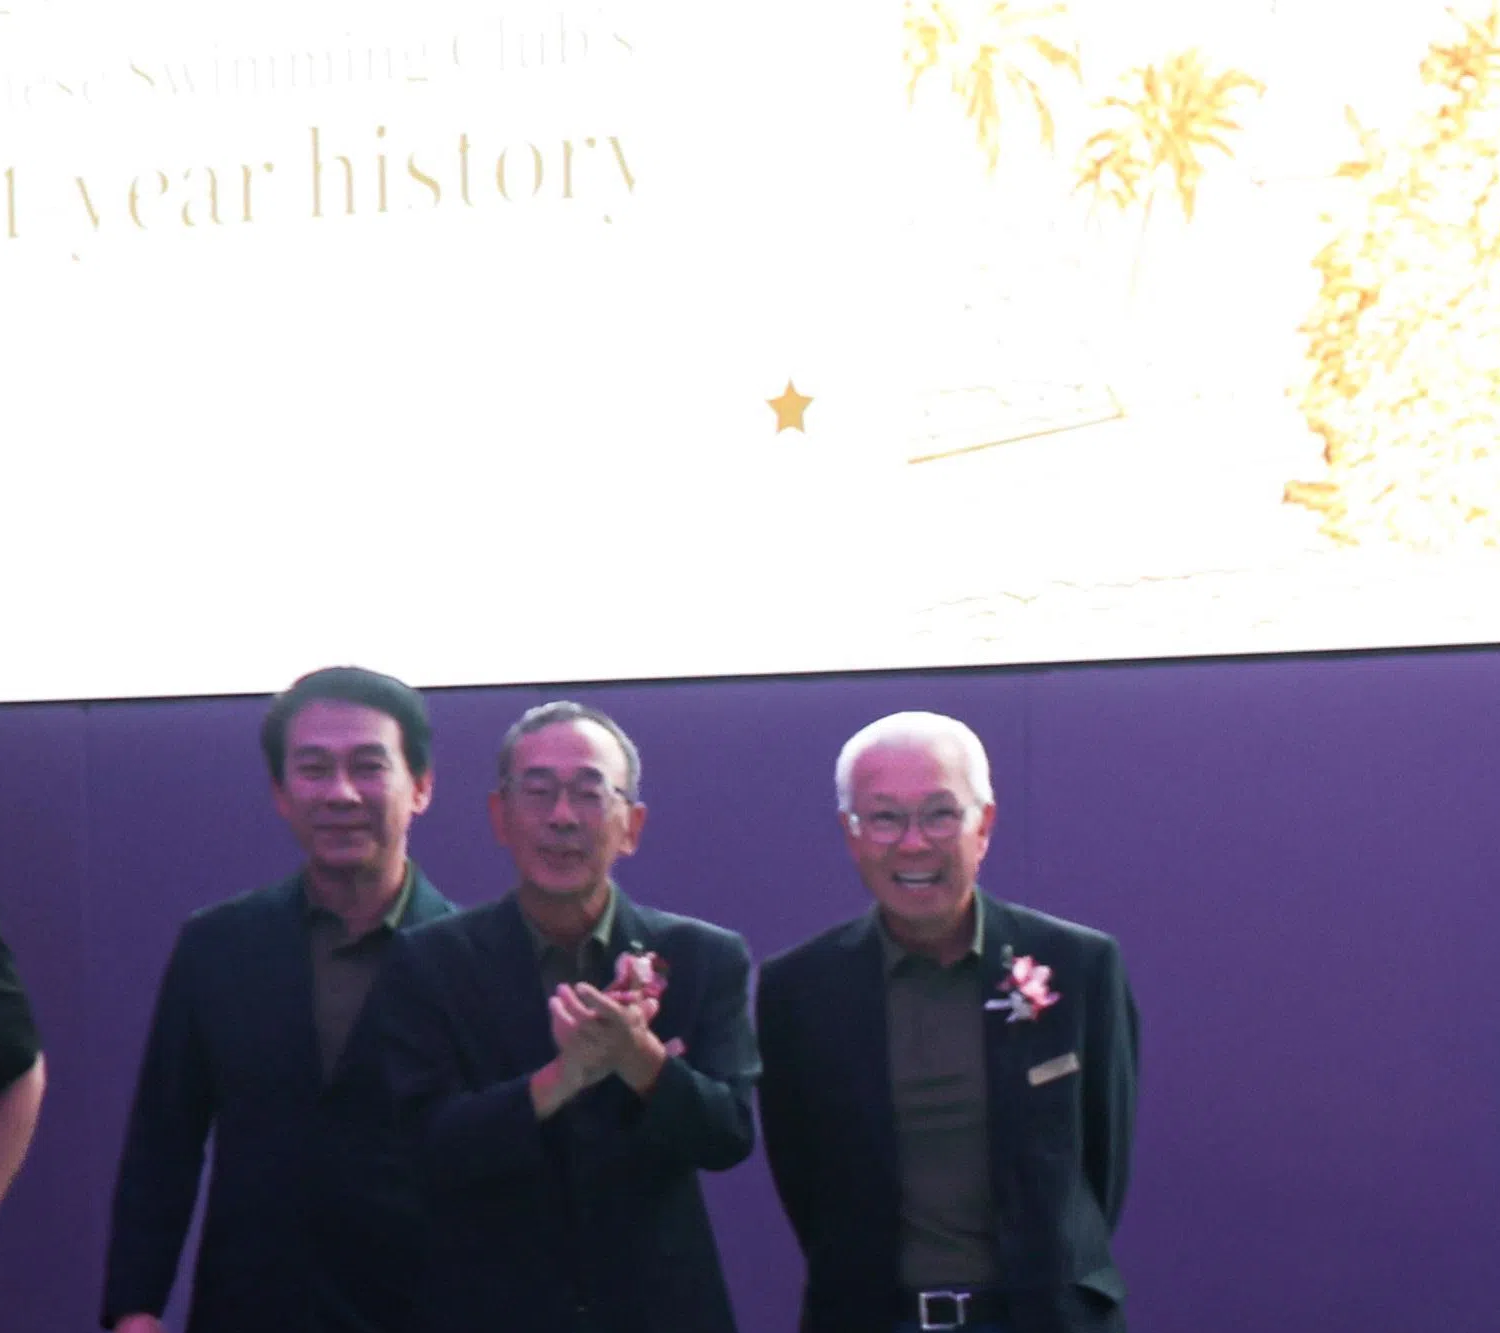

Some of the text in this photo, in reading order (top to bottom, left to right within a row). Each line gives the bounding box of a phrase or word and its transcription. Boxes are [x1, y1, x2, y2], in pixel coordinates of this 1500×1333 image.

[128, 32, 430, 98] Swimming
[70, 160, 275, 263] year
[308, 124, 637, 226] history
